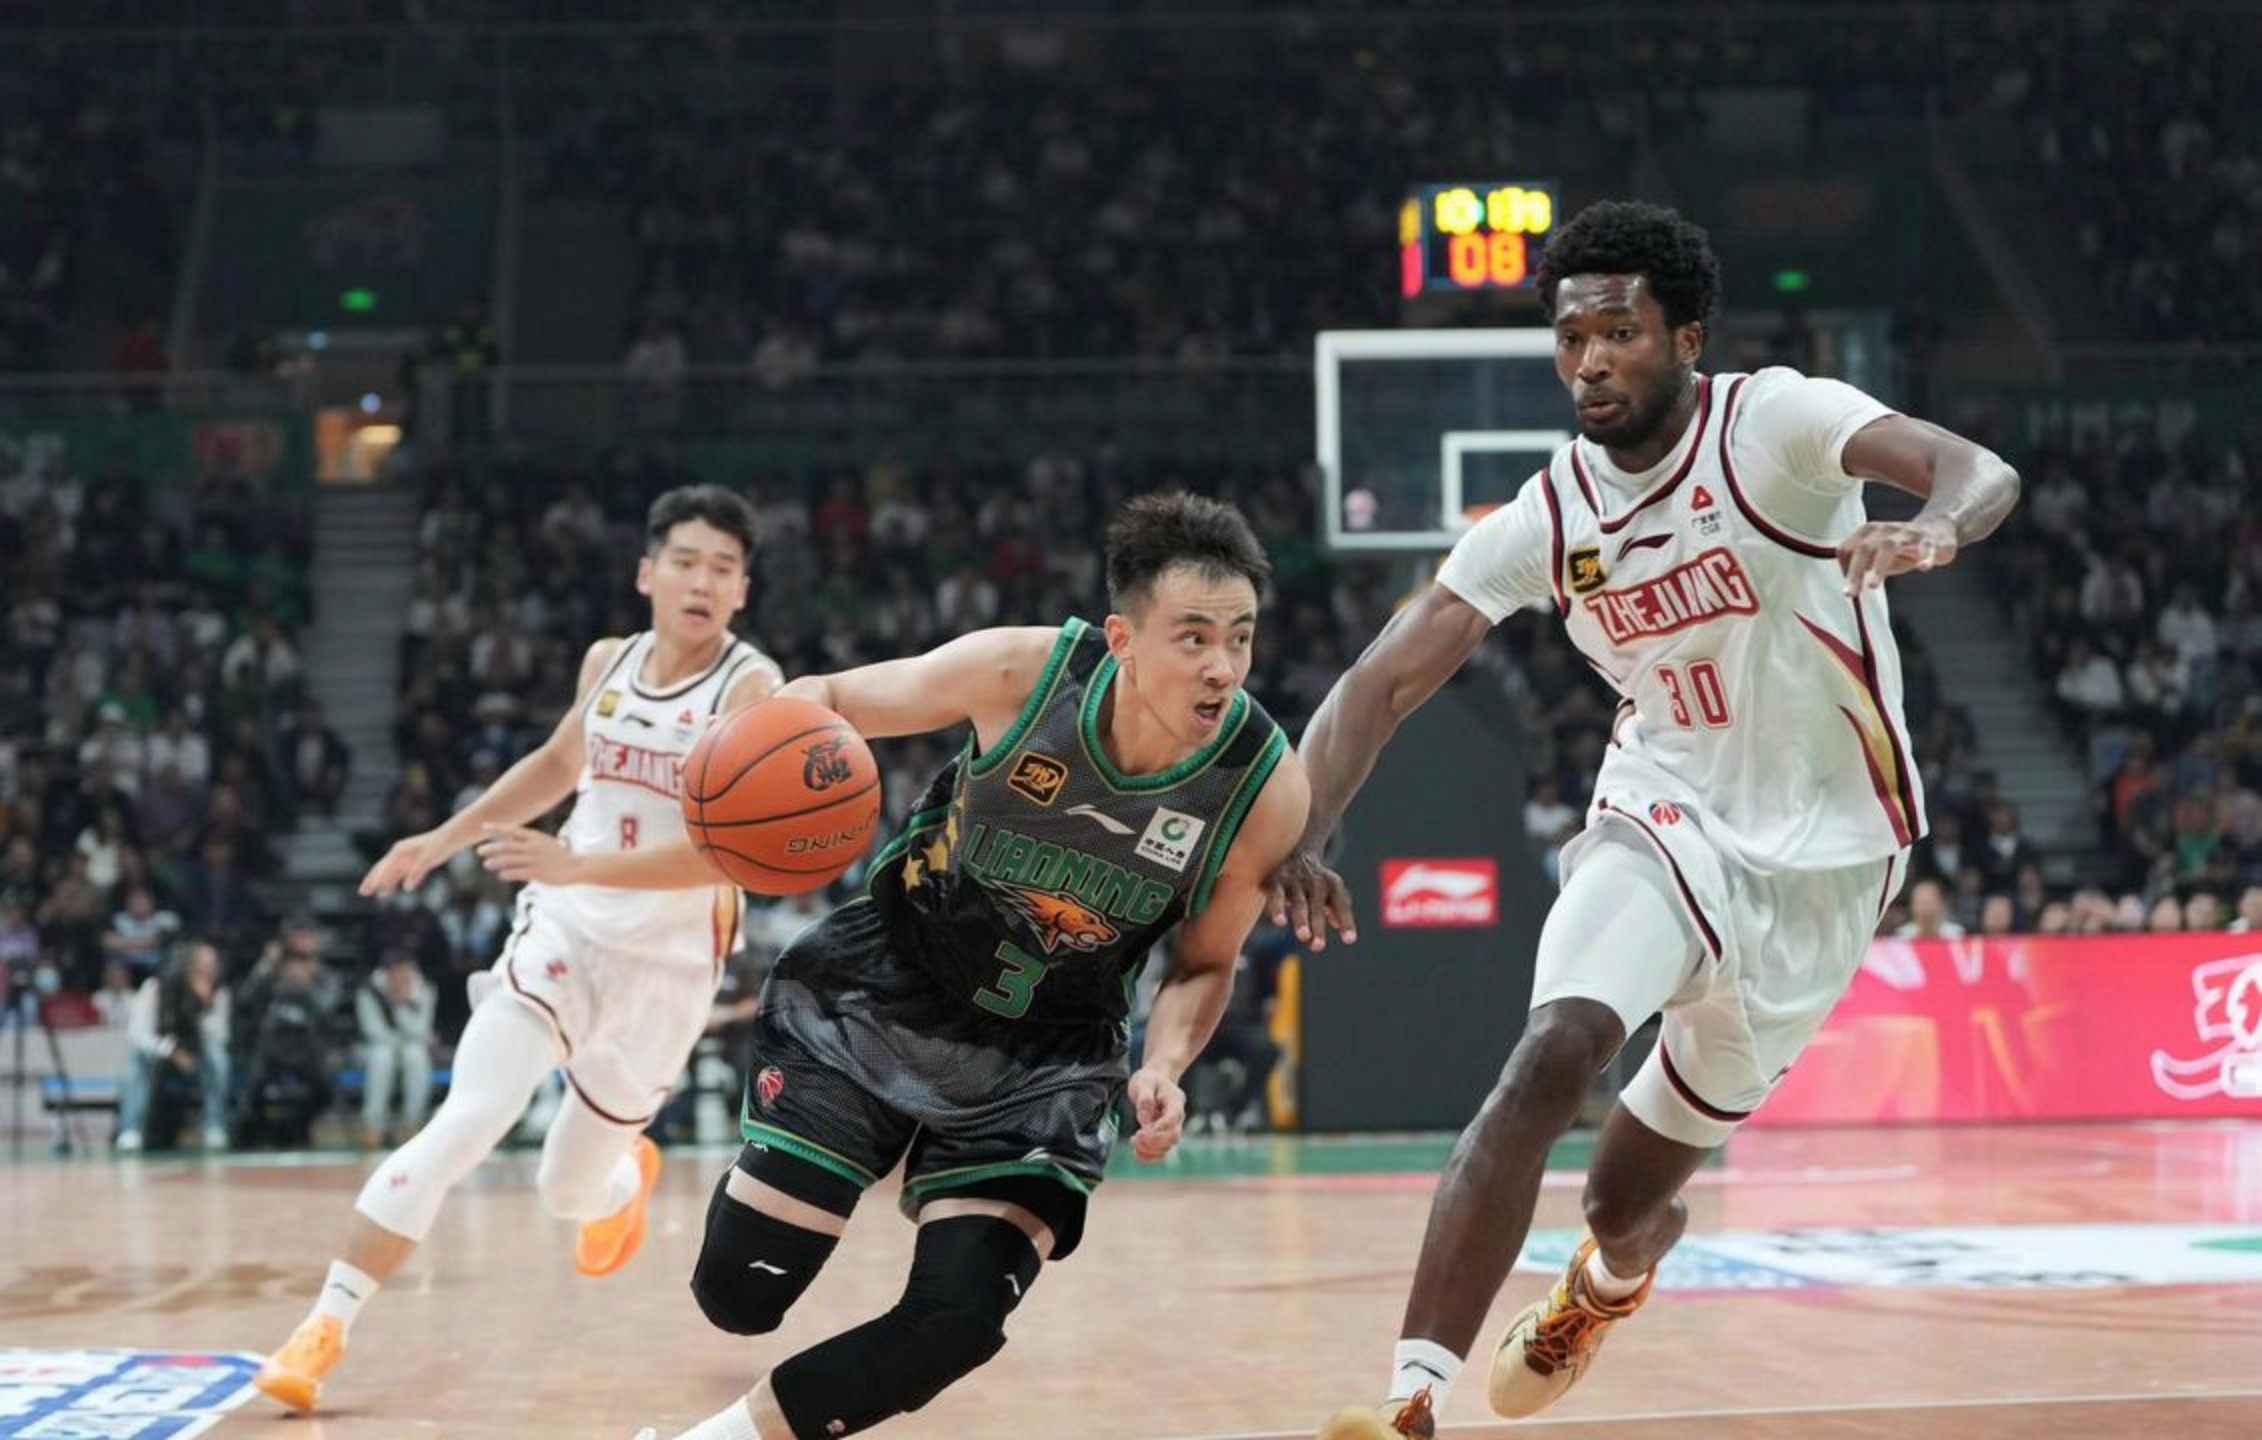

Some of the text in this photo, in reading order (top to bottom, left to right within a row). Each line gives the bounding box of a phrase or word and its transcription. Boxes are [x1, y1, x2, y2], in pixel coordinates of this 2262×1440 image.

[1449, 231, 1526, 287] 08
[1656, 660, 1733, 729] 30
[962, 823, 1175, 925] LIAONING
[973, 941, 1048, 1019] 3
